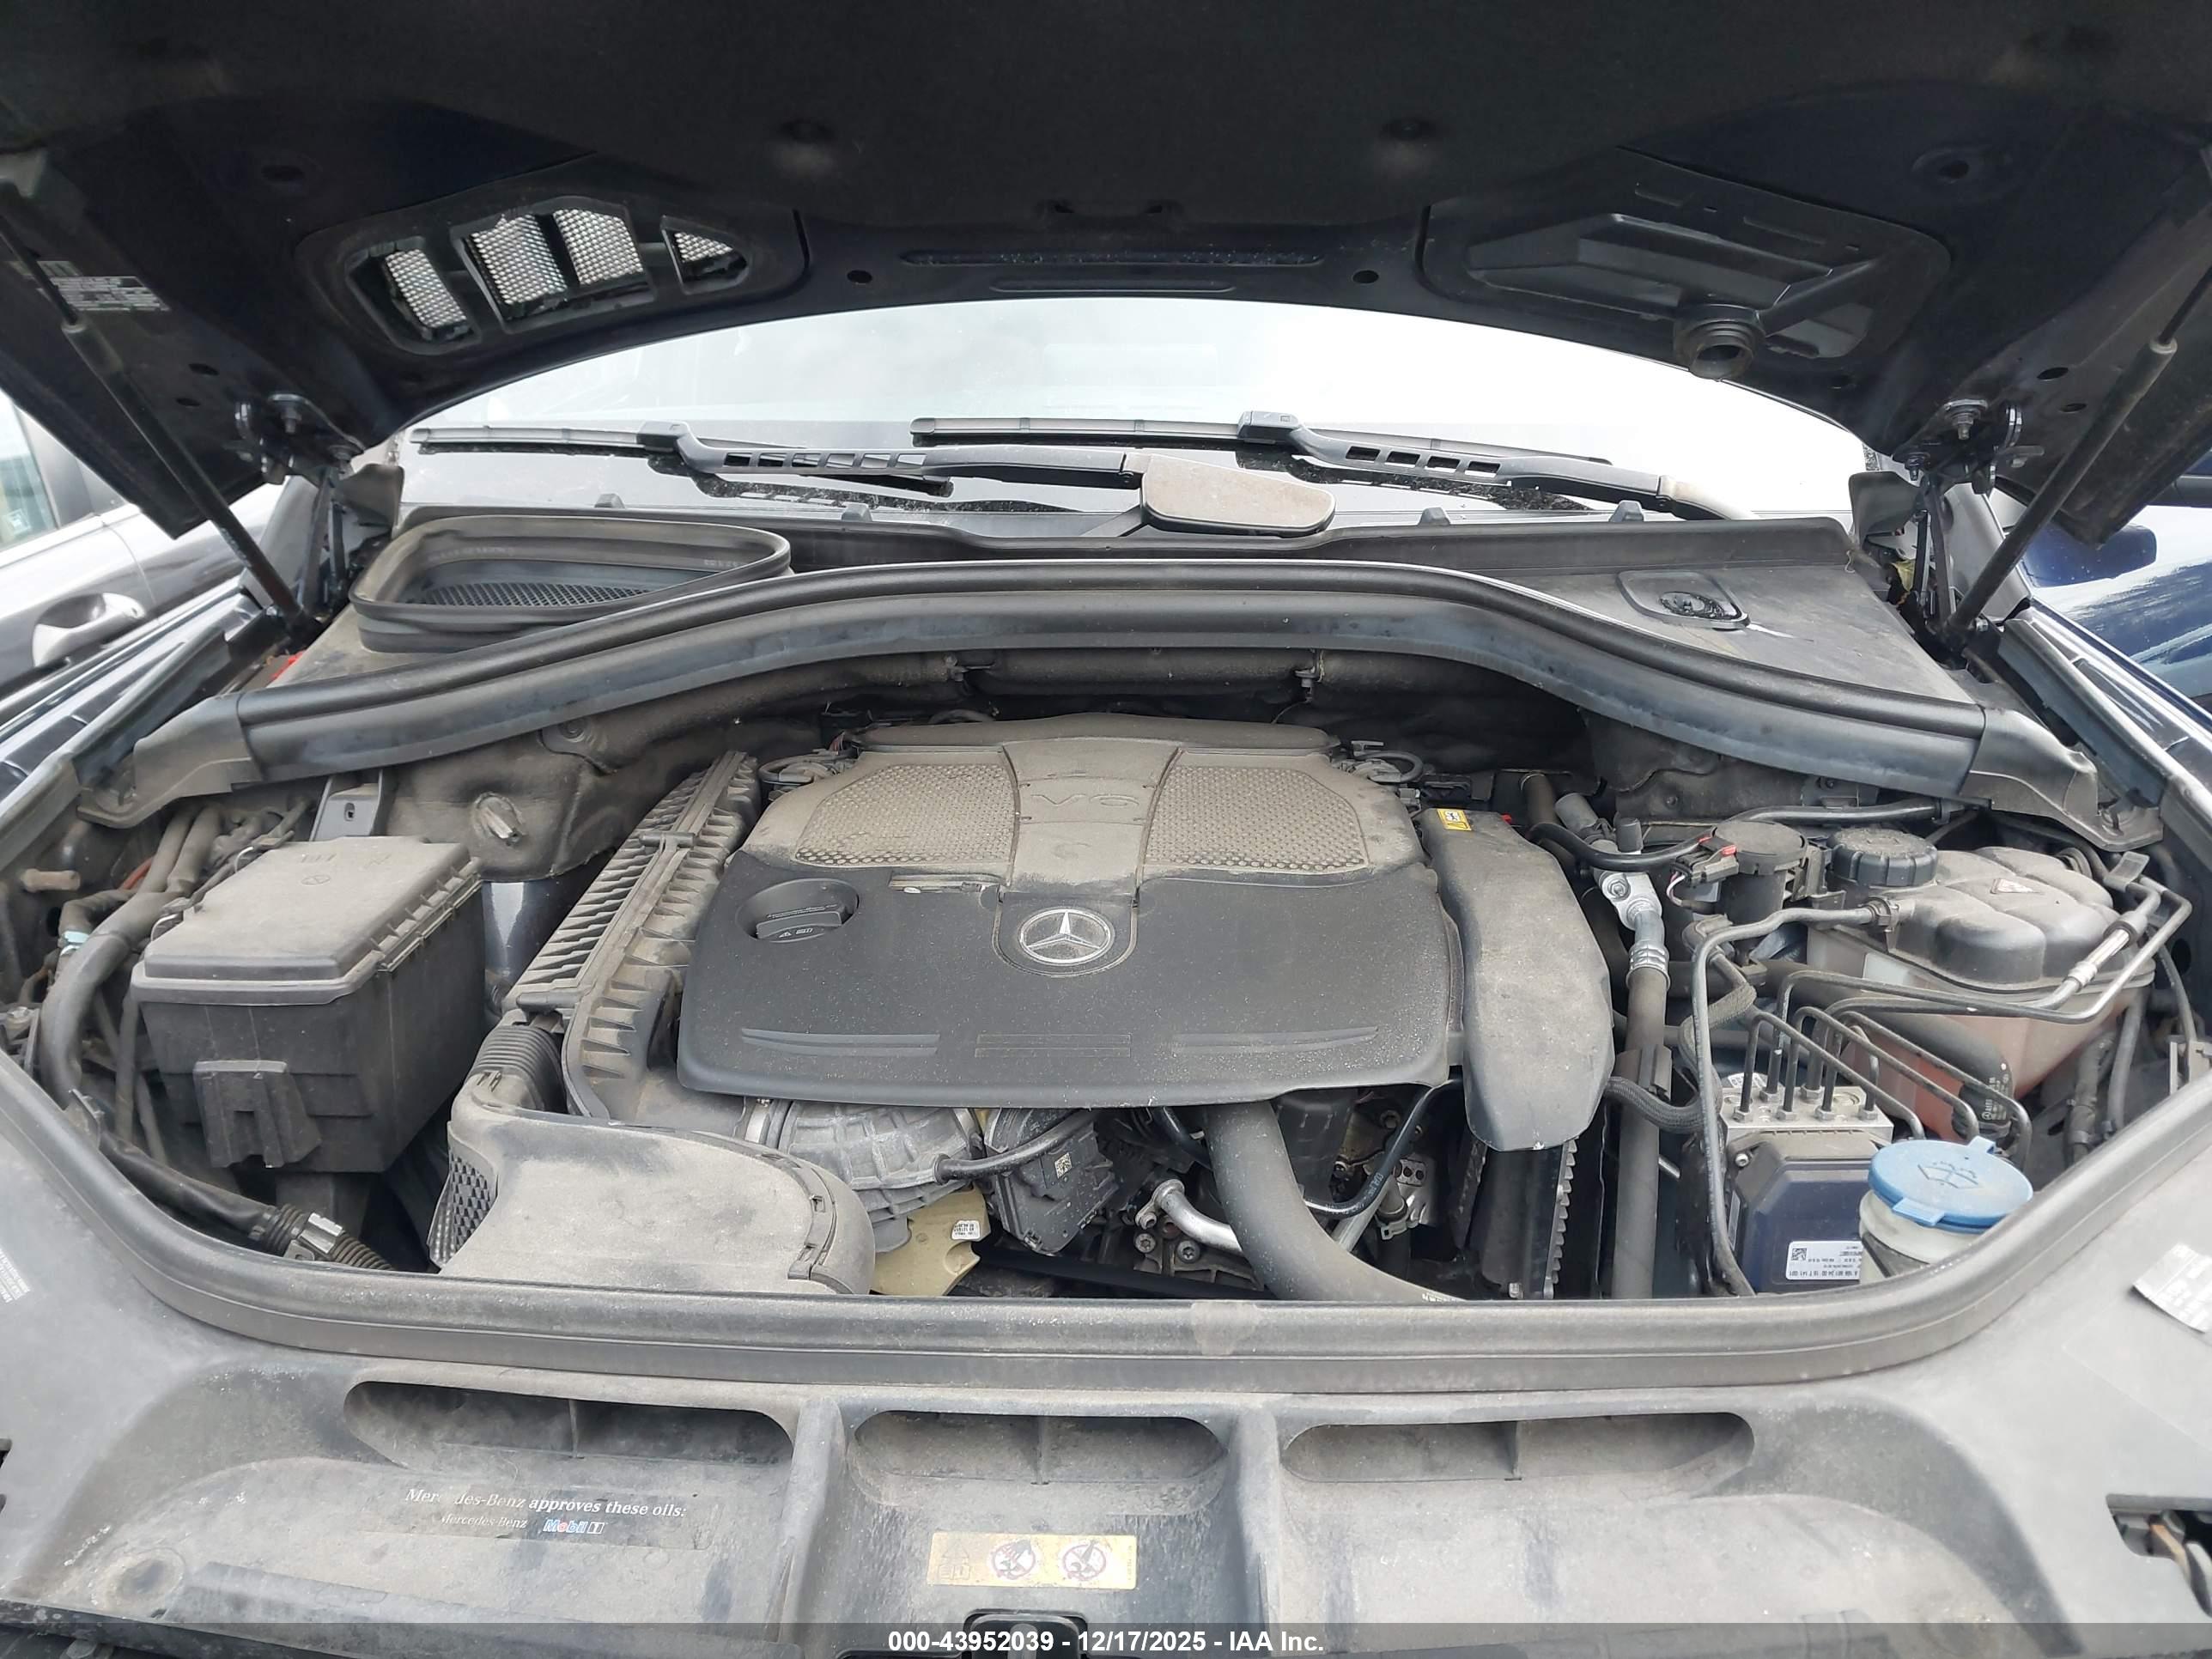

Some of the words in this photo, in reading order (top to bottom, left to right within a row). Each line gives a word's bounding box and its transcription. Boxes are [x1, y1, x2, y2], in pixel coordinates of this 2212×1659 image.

[405, 1488, 526, 1508] Merdes-Benz
[528, 1499, 601, 1512] approves
[605, 1501, 648, 1516] these
[652, 1504, 687, 1517] oils:
[543, 1519, 588, 1534] Mobil
